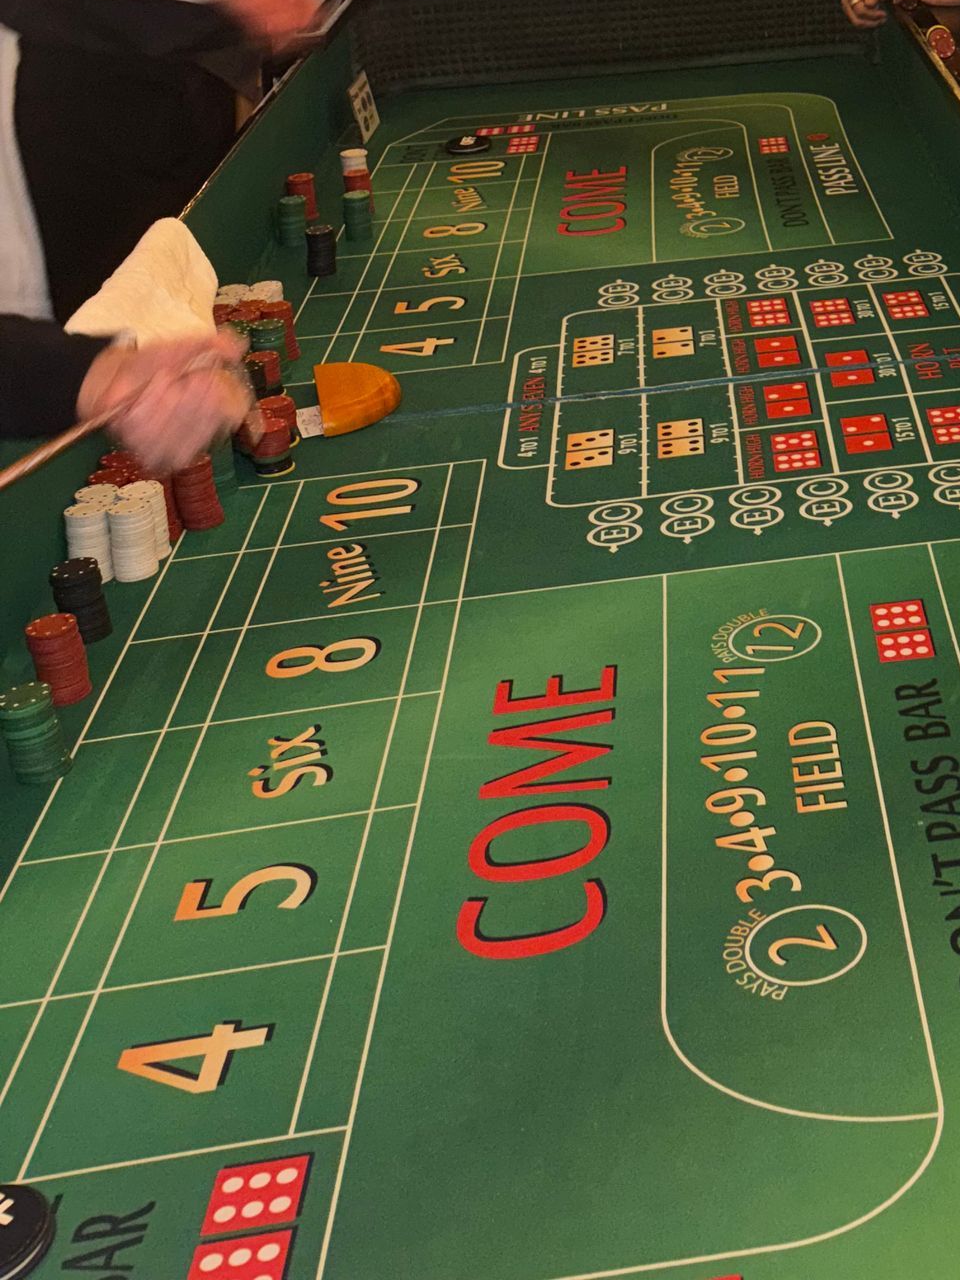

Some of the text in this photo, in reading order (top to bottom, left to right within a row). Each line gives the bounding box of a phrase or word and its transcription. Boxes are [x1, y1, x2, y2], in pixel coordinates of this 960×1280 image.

[446, 161, 506, 183] 10
[713, 175, 740, 199] FIELD
[809, 142, 859, 195] PASS LINE
[451, 186, 488, 213] Nine
[557, 166, 627, 237] COME
[423, 222, 488, 238] 8
[700, 222, 732, 232] 2
[422, 253, 466, 278] Six
[394, 296, 466, 314] 5
[380, 338, 455, 356] 4
[907, 343, 944, 380] HORN
[520, 376, 545, 411] SEVEN
[739, 386, 758, 426] HORN HIGH
[518, 412, 542, 433] ANY
[744, 434, 765, 480] HORN HIGH
[320, 477, 423, 531] 10
[322, 542, 383, 609] Nine
[265, 635, 383, 679] 8
[710, 608, 770, 663] PAYS DOUBLE
[745, 620, 806, 656] 12
[894, 677, 952, 742] BAR
[250, 723, 333, 799] Six
[787, 720, 848, 814] FIELD
[456, 665, 618, 960] COME
[173, 860, 318, 922] 5
[722, 907, 789, 1001] PAYS DOUBLE
[767, 923, 838, 967] 2
[117, 1019, 275, 1094] 4
[61, 1200, 157, 1280] AR
